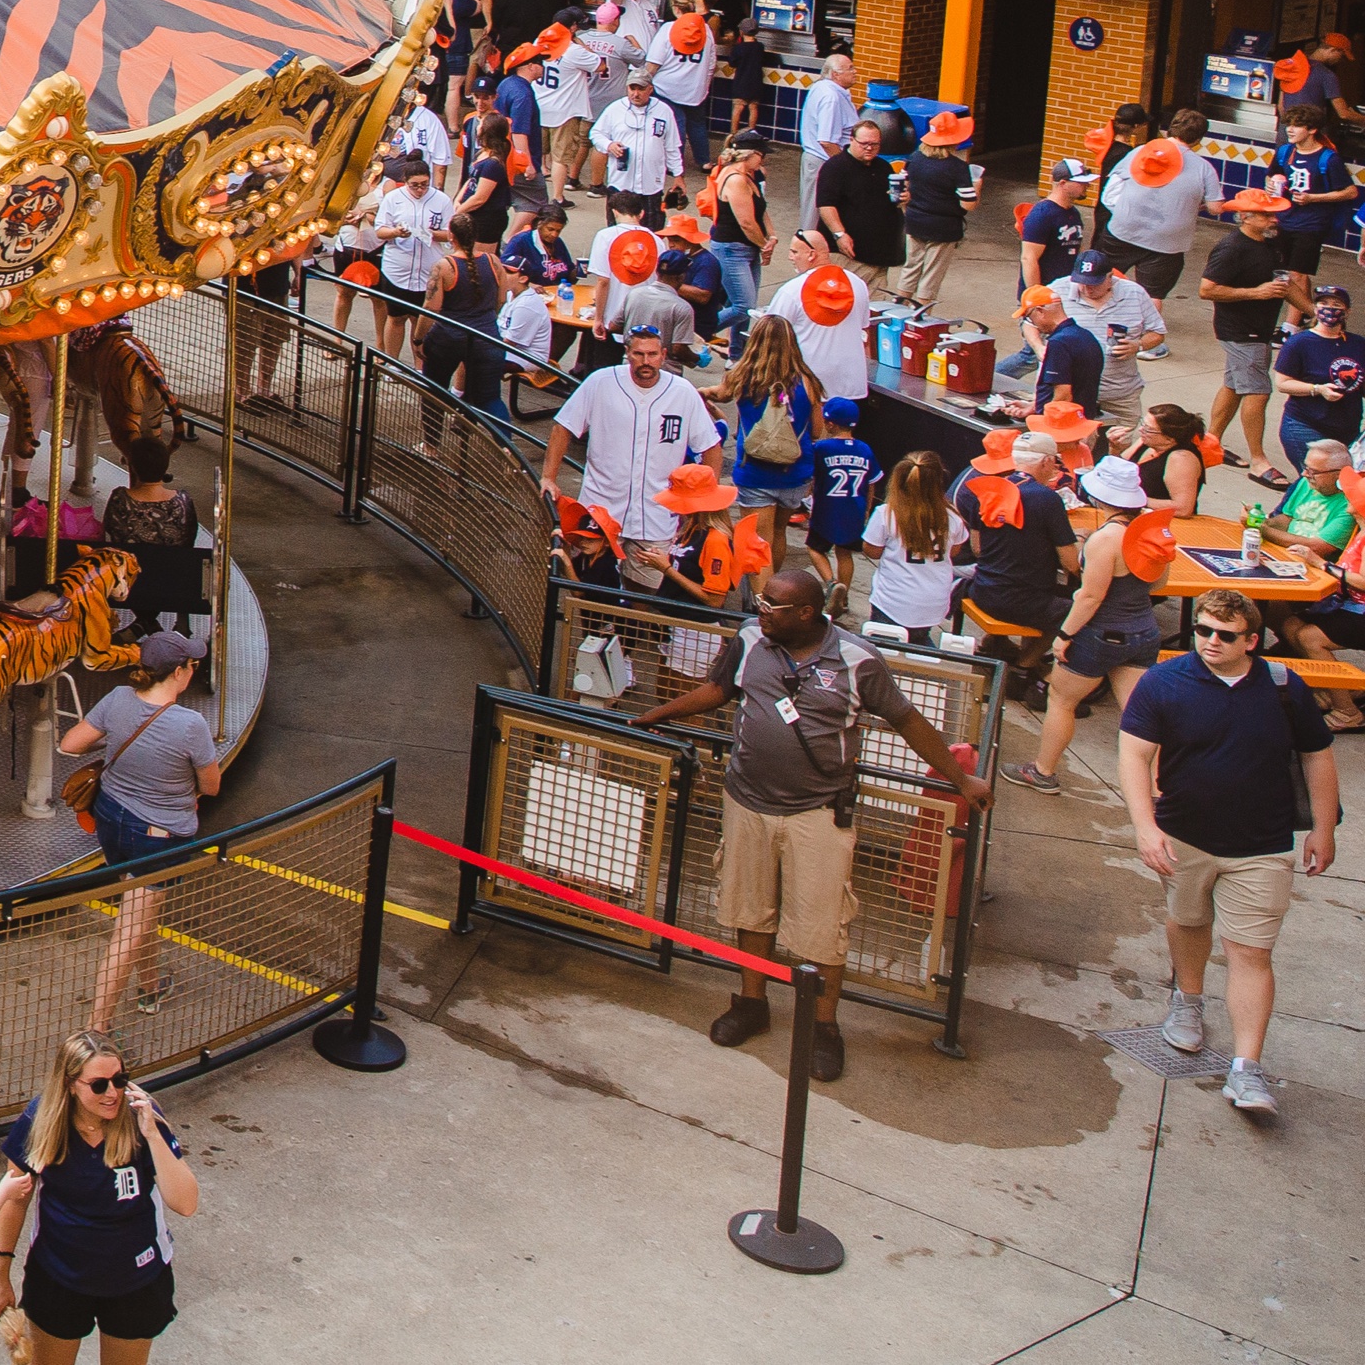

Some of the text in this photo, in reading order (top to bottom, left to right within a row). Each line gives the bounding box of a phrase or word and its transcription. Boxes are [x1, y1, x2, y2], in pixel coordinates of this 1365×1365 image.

[1289, 164, 1310, 192] D
[429, 209, 443, 231] D
[659, 414, 683, 445] D
[826, 468, 868, 498] 27
[114, 1166, 140, 1201] D
